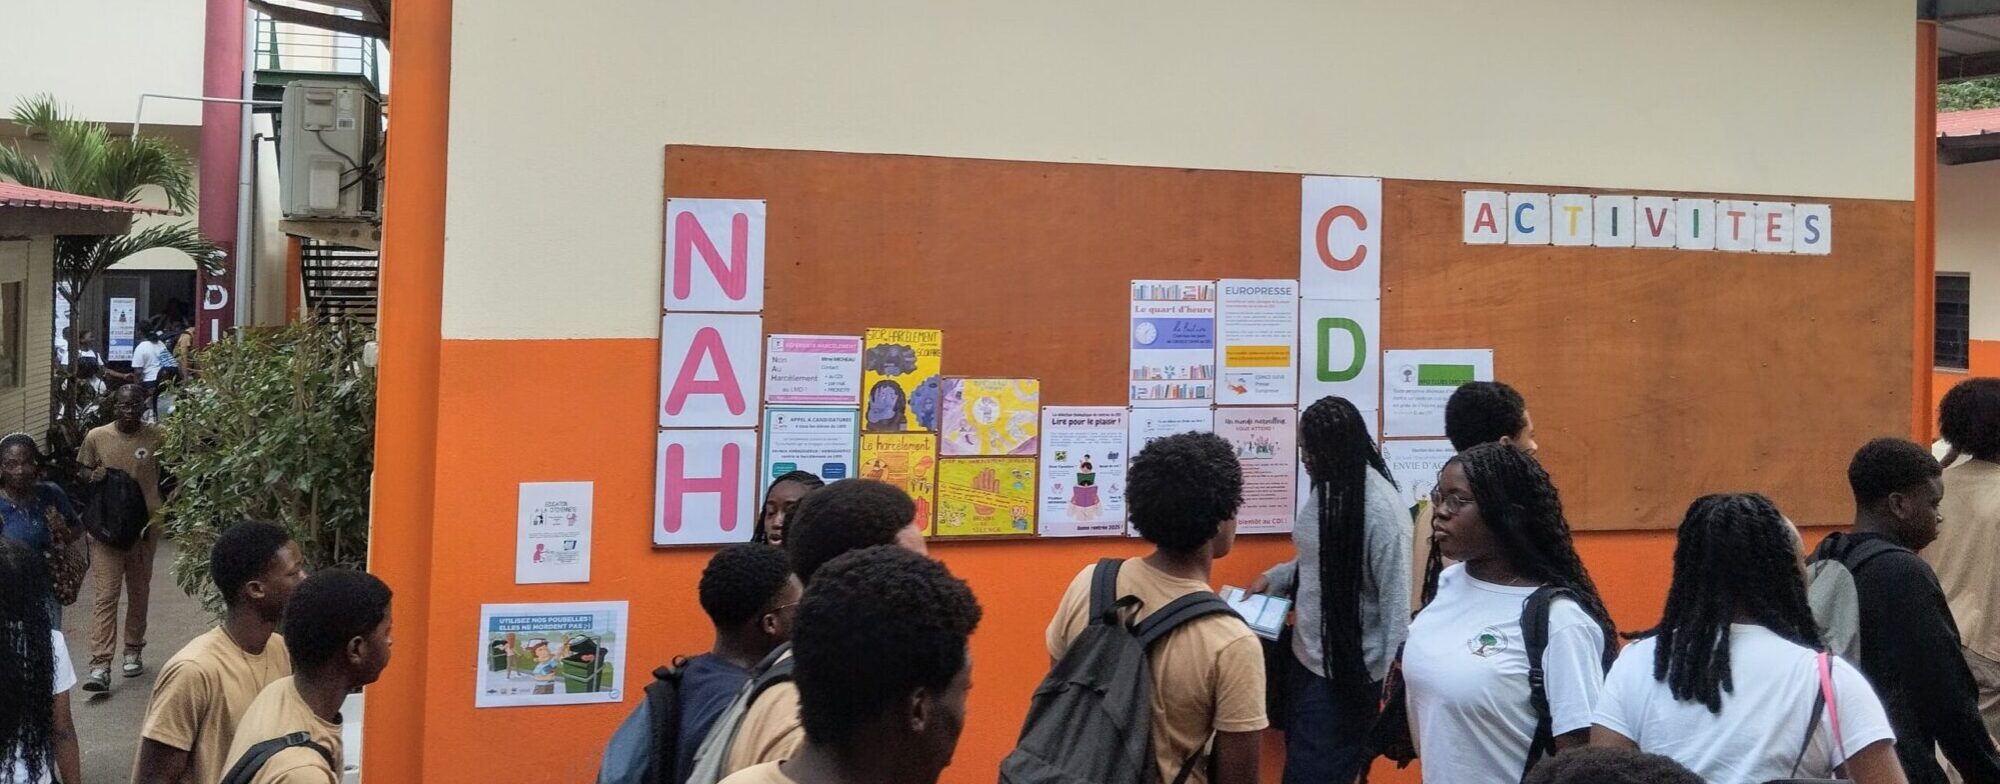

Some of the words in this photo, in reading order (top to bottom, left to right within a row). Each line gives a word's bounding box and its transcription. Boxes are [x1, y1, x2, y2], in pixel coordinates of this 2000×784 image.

[1472, 202, 1821, 244] ACTIVITES
[1225, 286, 1292, 295] EUROPRESSE
[1316, 205, 1367, 382] CD
[1148, 306, 1176, 314] quart
[1178, 305, 1212, 313] d'heure
[663, 211, 749, 533] NAH
[1068, 419, 1085, 427] pour
[1095, 418, 1117, 427] plaisir
[1393, 462, 1420, 470] ENVIE
[1422, 461, 1444, 470] D'AG
[532, 623, 567, 631] MORDENT
[569, 622, 583, 630] PAS
